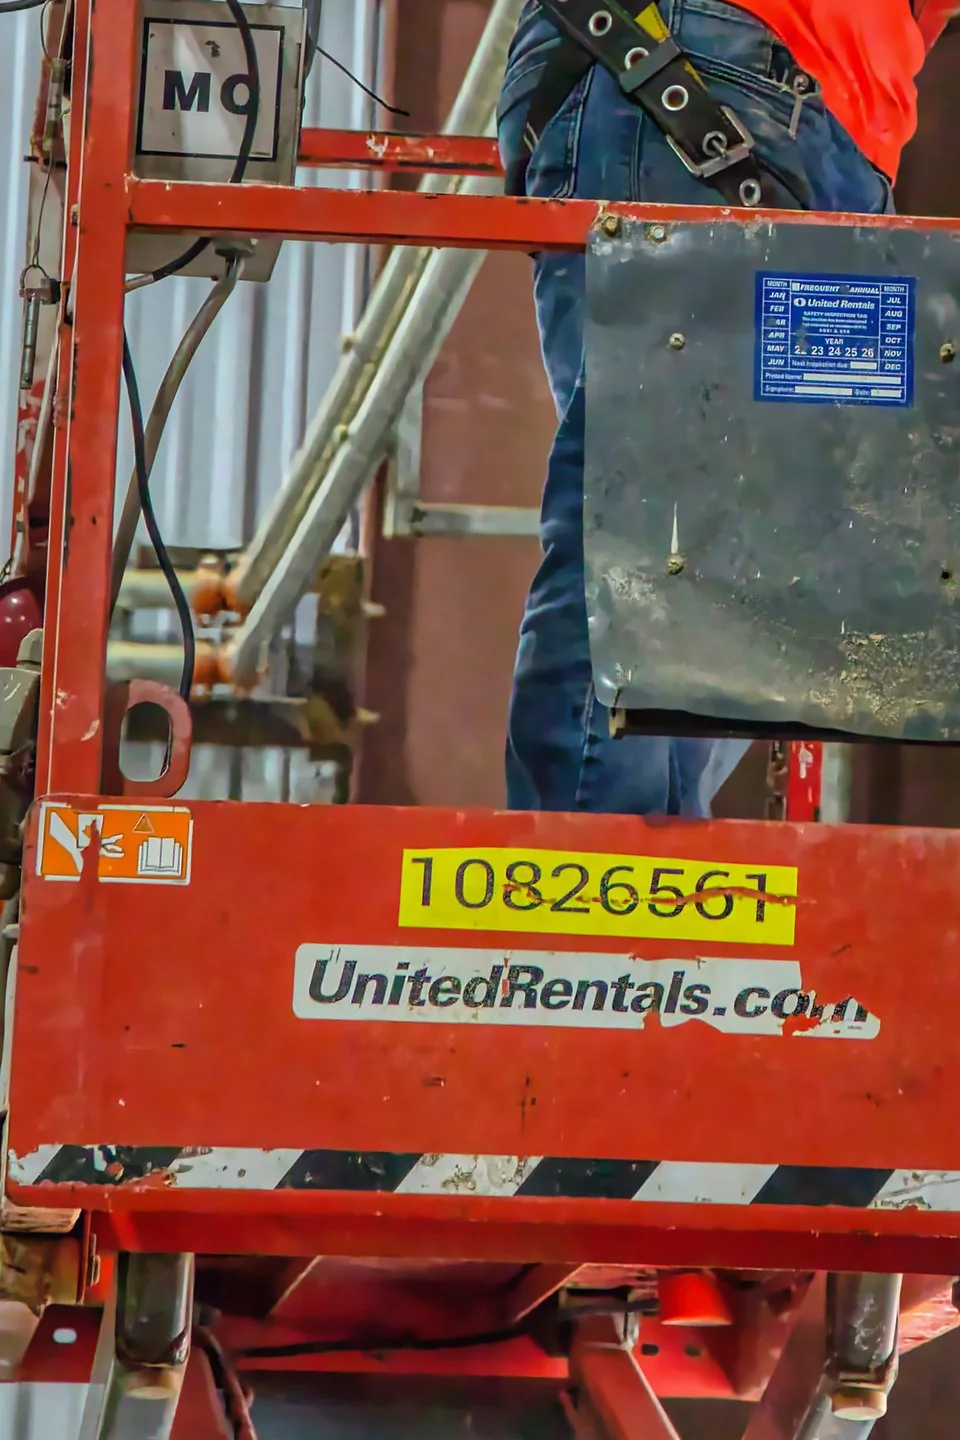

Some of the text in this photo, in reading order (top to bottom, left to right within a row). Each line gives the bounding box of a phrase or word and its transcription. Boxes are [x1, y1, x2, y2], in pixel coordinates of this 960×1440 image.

[769, 292, 786, 300] JAN
[808, 299, 875, 309] United Rentals
[811, 346, 824, 356] 23
[828, 347, 841, 356] 24
[845, 348, 858, 357] 25
[862, 348, 874, 358] 26
[884, 363, 901, 371] DEC
[411, 857, 768, 923] 10826561
